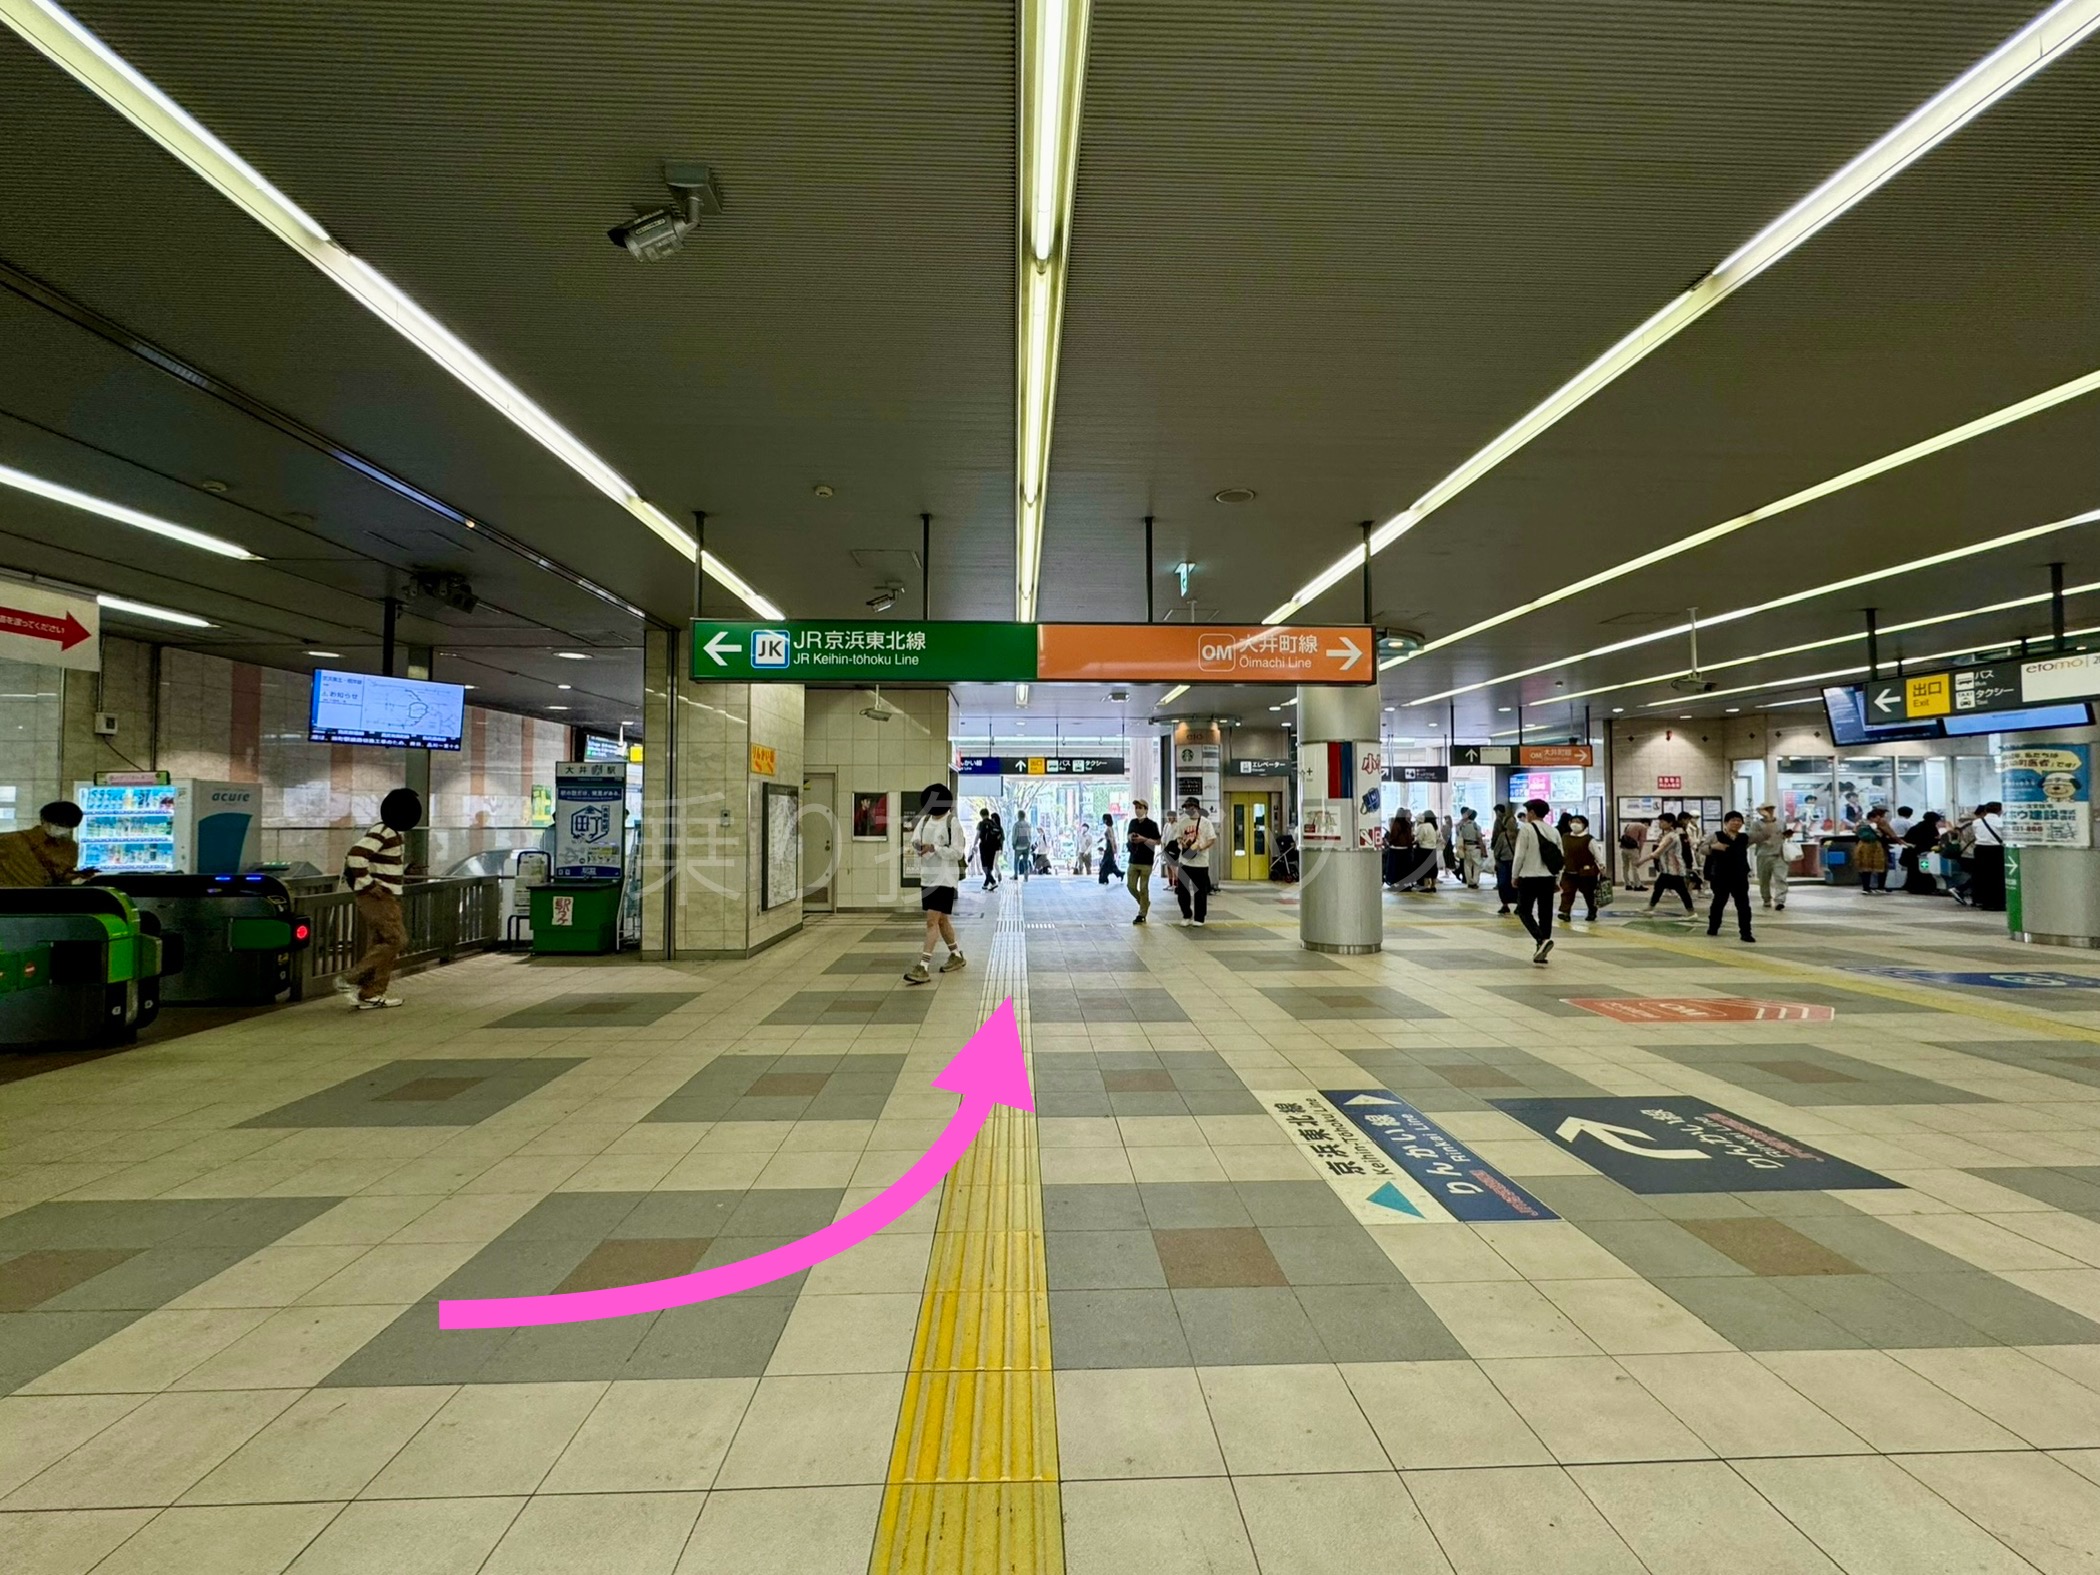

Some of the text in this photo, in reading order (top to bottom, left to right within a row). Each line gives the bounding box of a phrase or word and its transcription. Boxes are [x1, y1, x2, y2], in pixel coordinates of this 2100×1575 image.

[757, 640, 783, 657] JK
[793, 631, 926, 650] JR京浜東北線
[1239, 635, 1318, 653] 大井町線
[793, 653, 809, 665] JR
[894, 653, 920, 665] Line
[1201, 645, 1233, 661] OM
[1288, 657, 1311, 668] Line
[2025, 657, 2083, 674] etomo
[1974, 669, 1995, 680] バス
[1912, 681, 1943, 698] 出口
[1975, 687, 2015, 699] タクシー
[1913, 699, 1930, 708] Exit
[1252, 761, 1286, 769] エレベーター
[211, 790, 251, 802] acure
[1274, 1102, 1367, 1176] 京浜東北線
[1401, 1113, 1471, 1163] Rinkai Line
[1640, 1108, 1786, 1170] りんかい線
[1364, 1114, 1485, 1196] りんかい線
